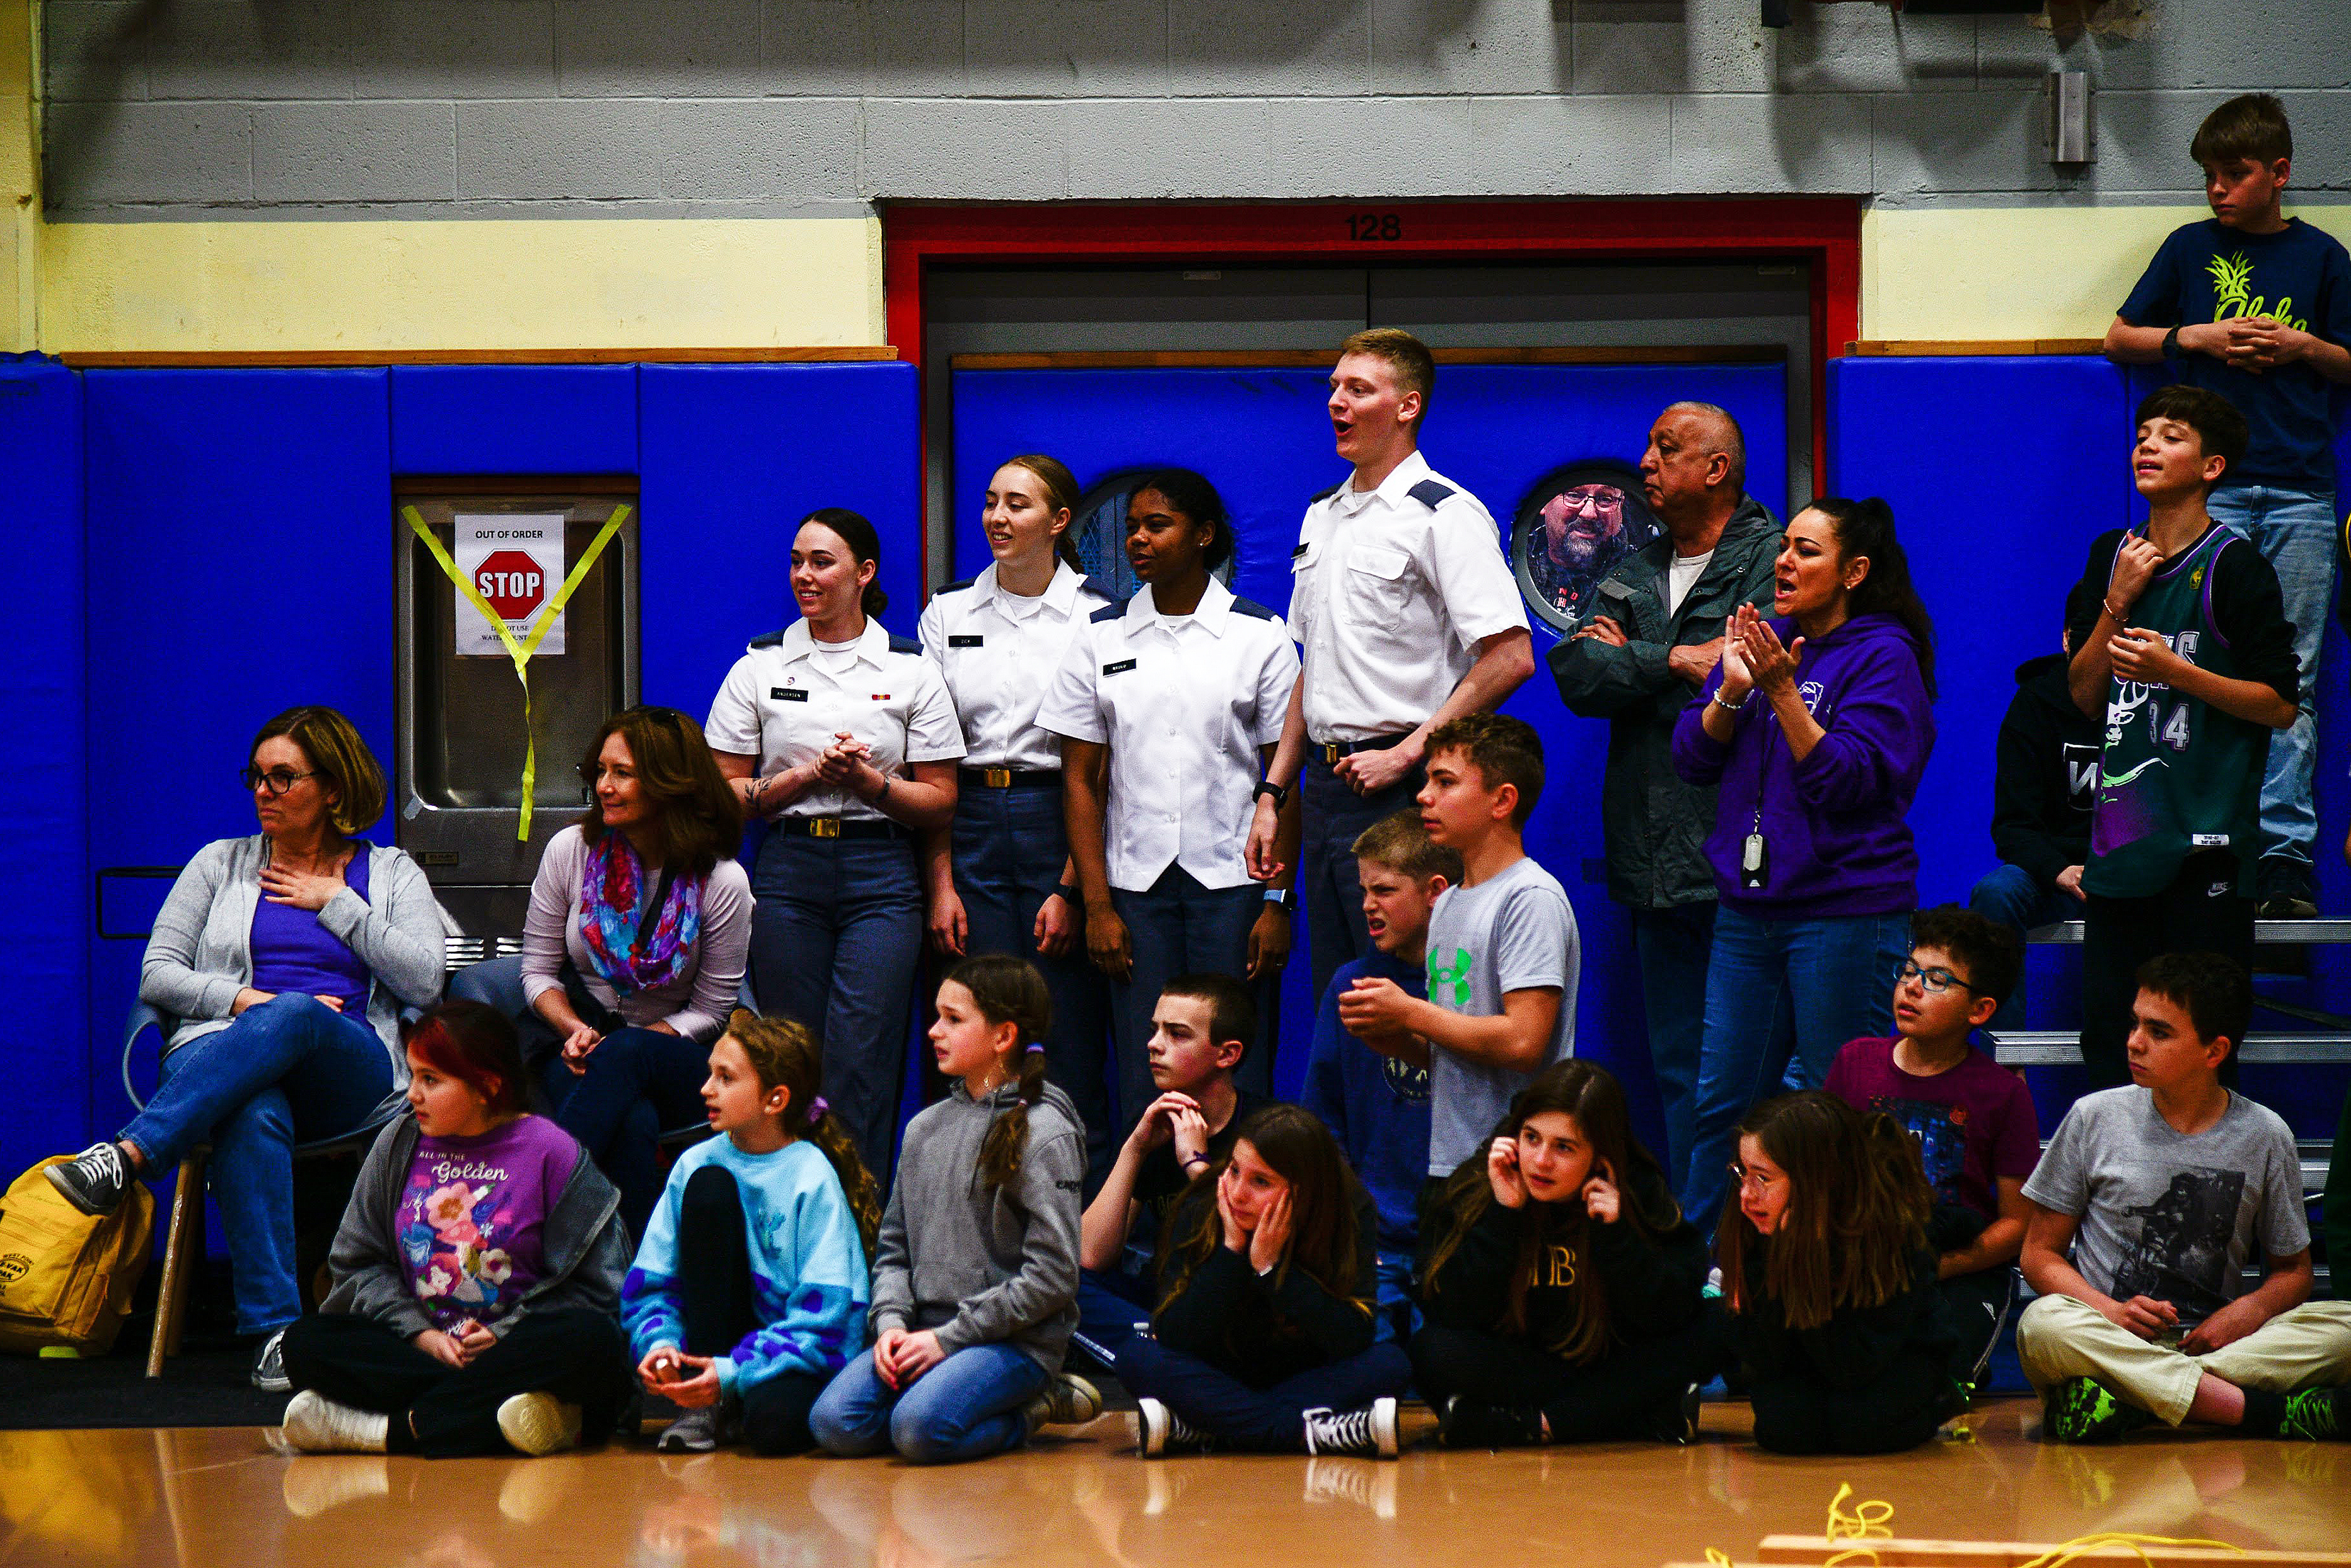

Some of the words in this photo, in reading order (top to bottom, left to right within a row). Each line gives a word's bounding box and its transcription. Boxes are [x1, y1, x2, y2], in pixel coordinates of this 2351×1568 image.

[1345, 214, 1401, 241] 128
[2214, 296, 2308, 333] Alha
[475, 530, 495, 539] OUT
[497, 530, 509, 539] OF
[512, 530, 543, 539] ORDER
[479, 571, 540, 598] STOP
[419, 1151, 434, 1160] ALL
[438, 1151, 447, 1160] IN
[431, 1161, 509, 1184] Golden
